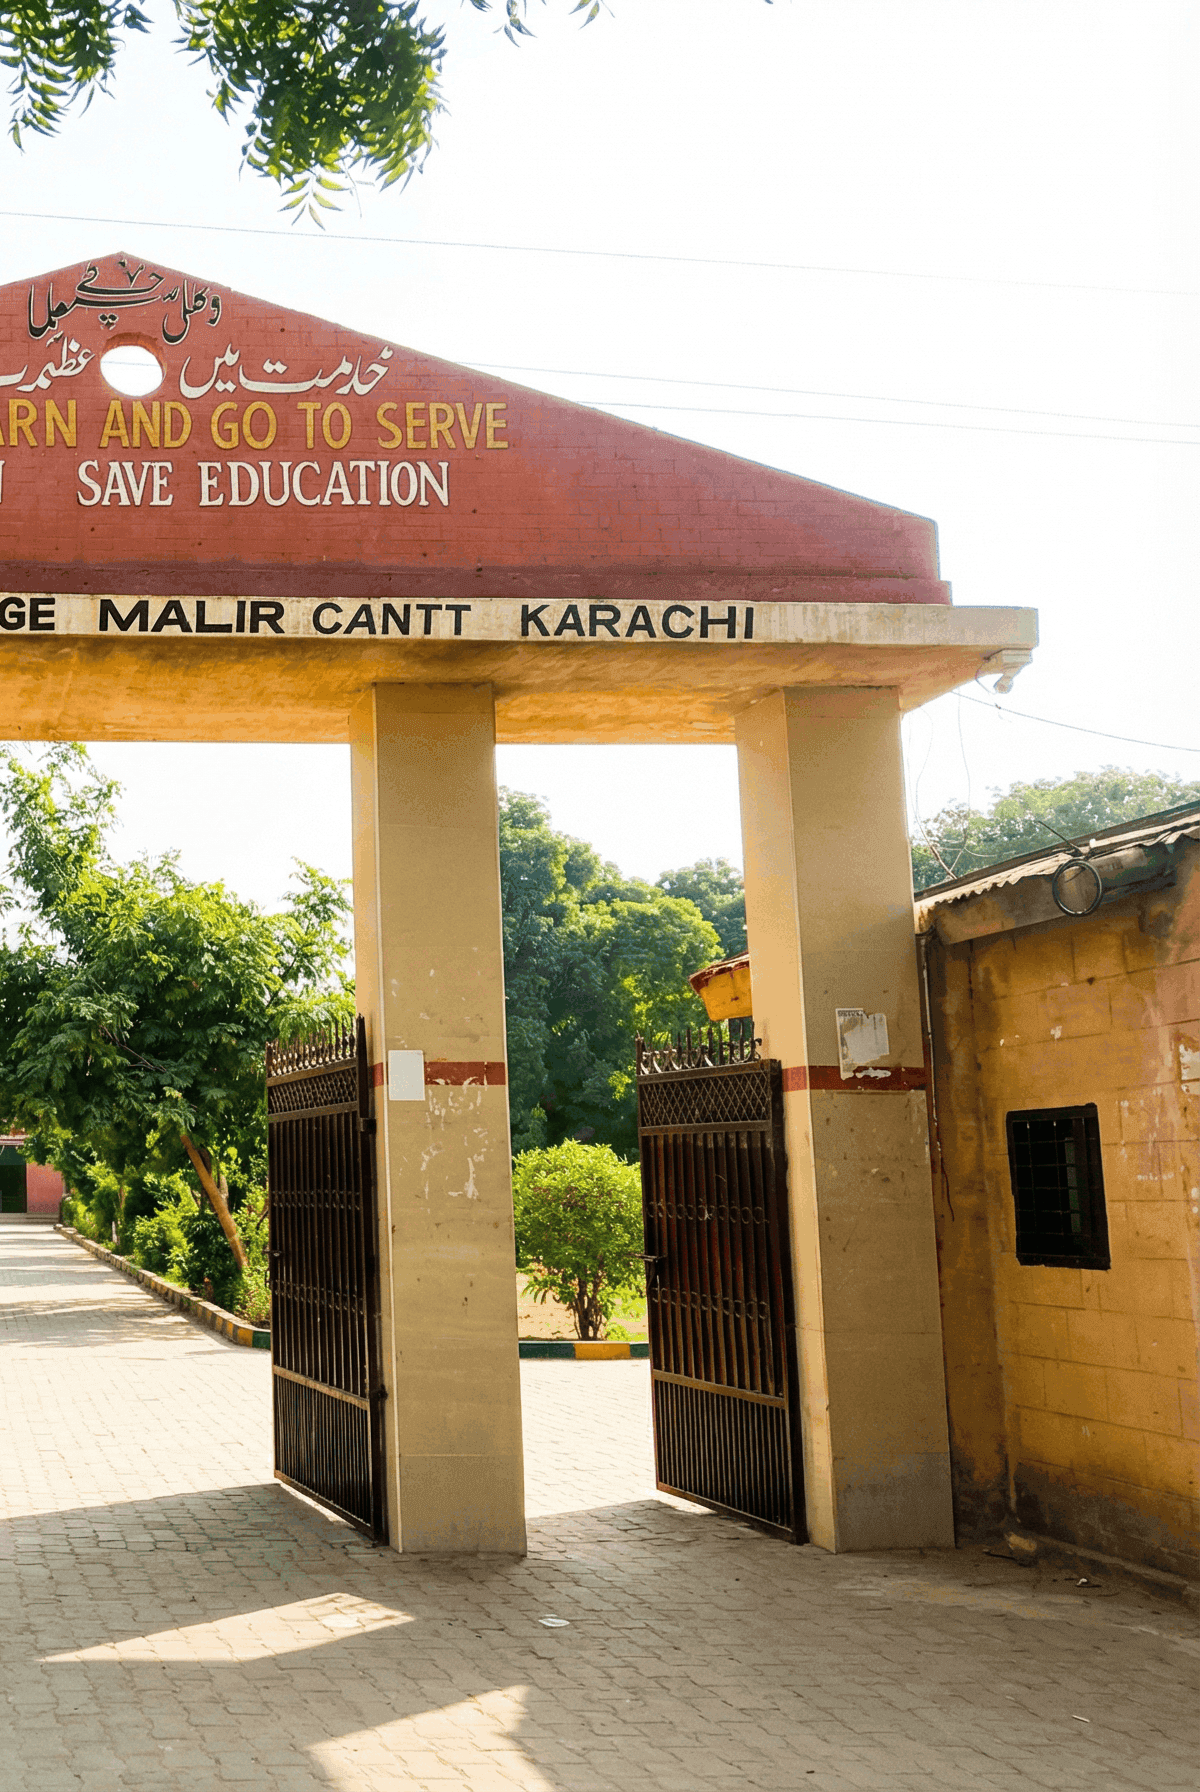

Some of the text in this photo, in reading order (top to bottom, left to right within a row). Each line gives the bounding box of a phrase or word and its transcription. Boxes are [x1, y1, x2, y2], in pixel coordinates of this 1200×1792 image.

[179, 343, 241, 399] میں
[238, 345, 394, 396] خدمت
[99, 400, 192, 449] AND
[210, 401, 278, 450] GO
[297, 402, 353, 450] TO
[377, 402, 509, 450] SERVE
[76, 459, 174, 507] SAVE
[198, 460, 450, 508] EDUCATION
[99, 598, 286, 634] MALIR
[312, 602, 472, 636] CANTT
[520, 604, 755, 639] KARACHI
